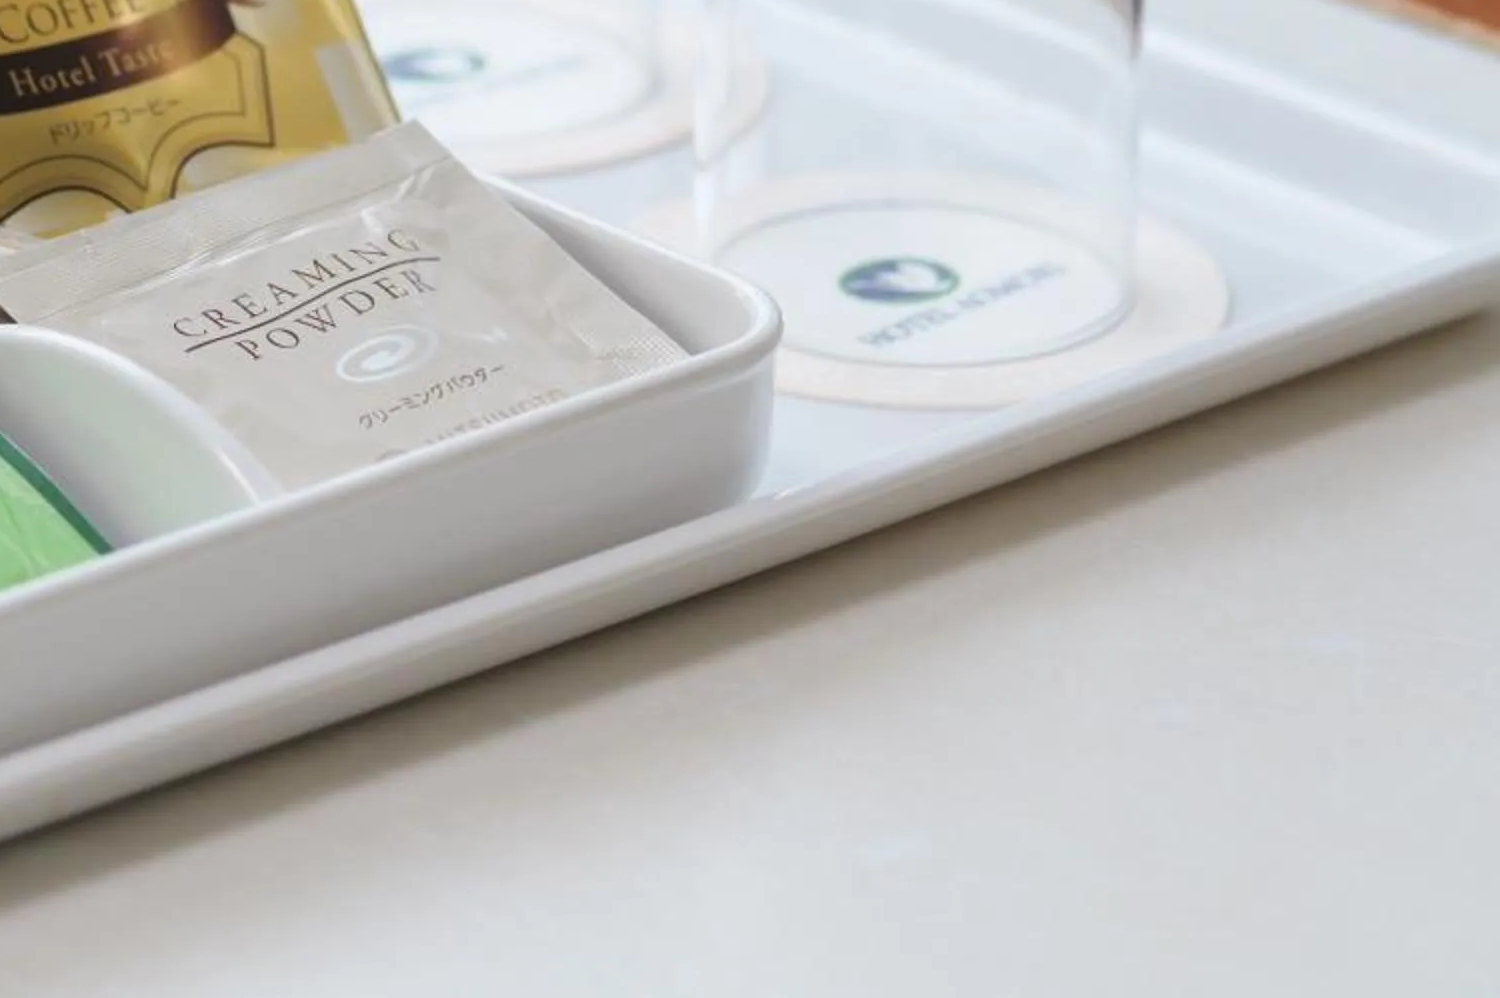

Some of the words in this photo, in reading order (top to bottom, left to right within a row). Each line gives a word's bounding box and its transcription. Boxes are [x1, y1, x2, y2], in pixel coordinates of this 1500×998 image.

[8, 55, 97, 98] Hotel
[98, 41, 172, 78] Taste
[173, 227, 421, 339] CREAMING
[235, 268, 438, 361] POWDER
